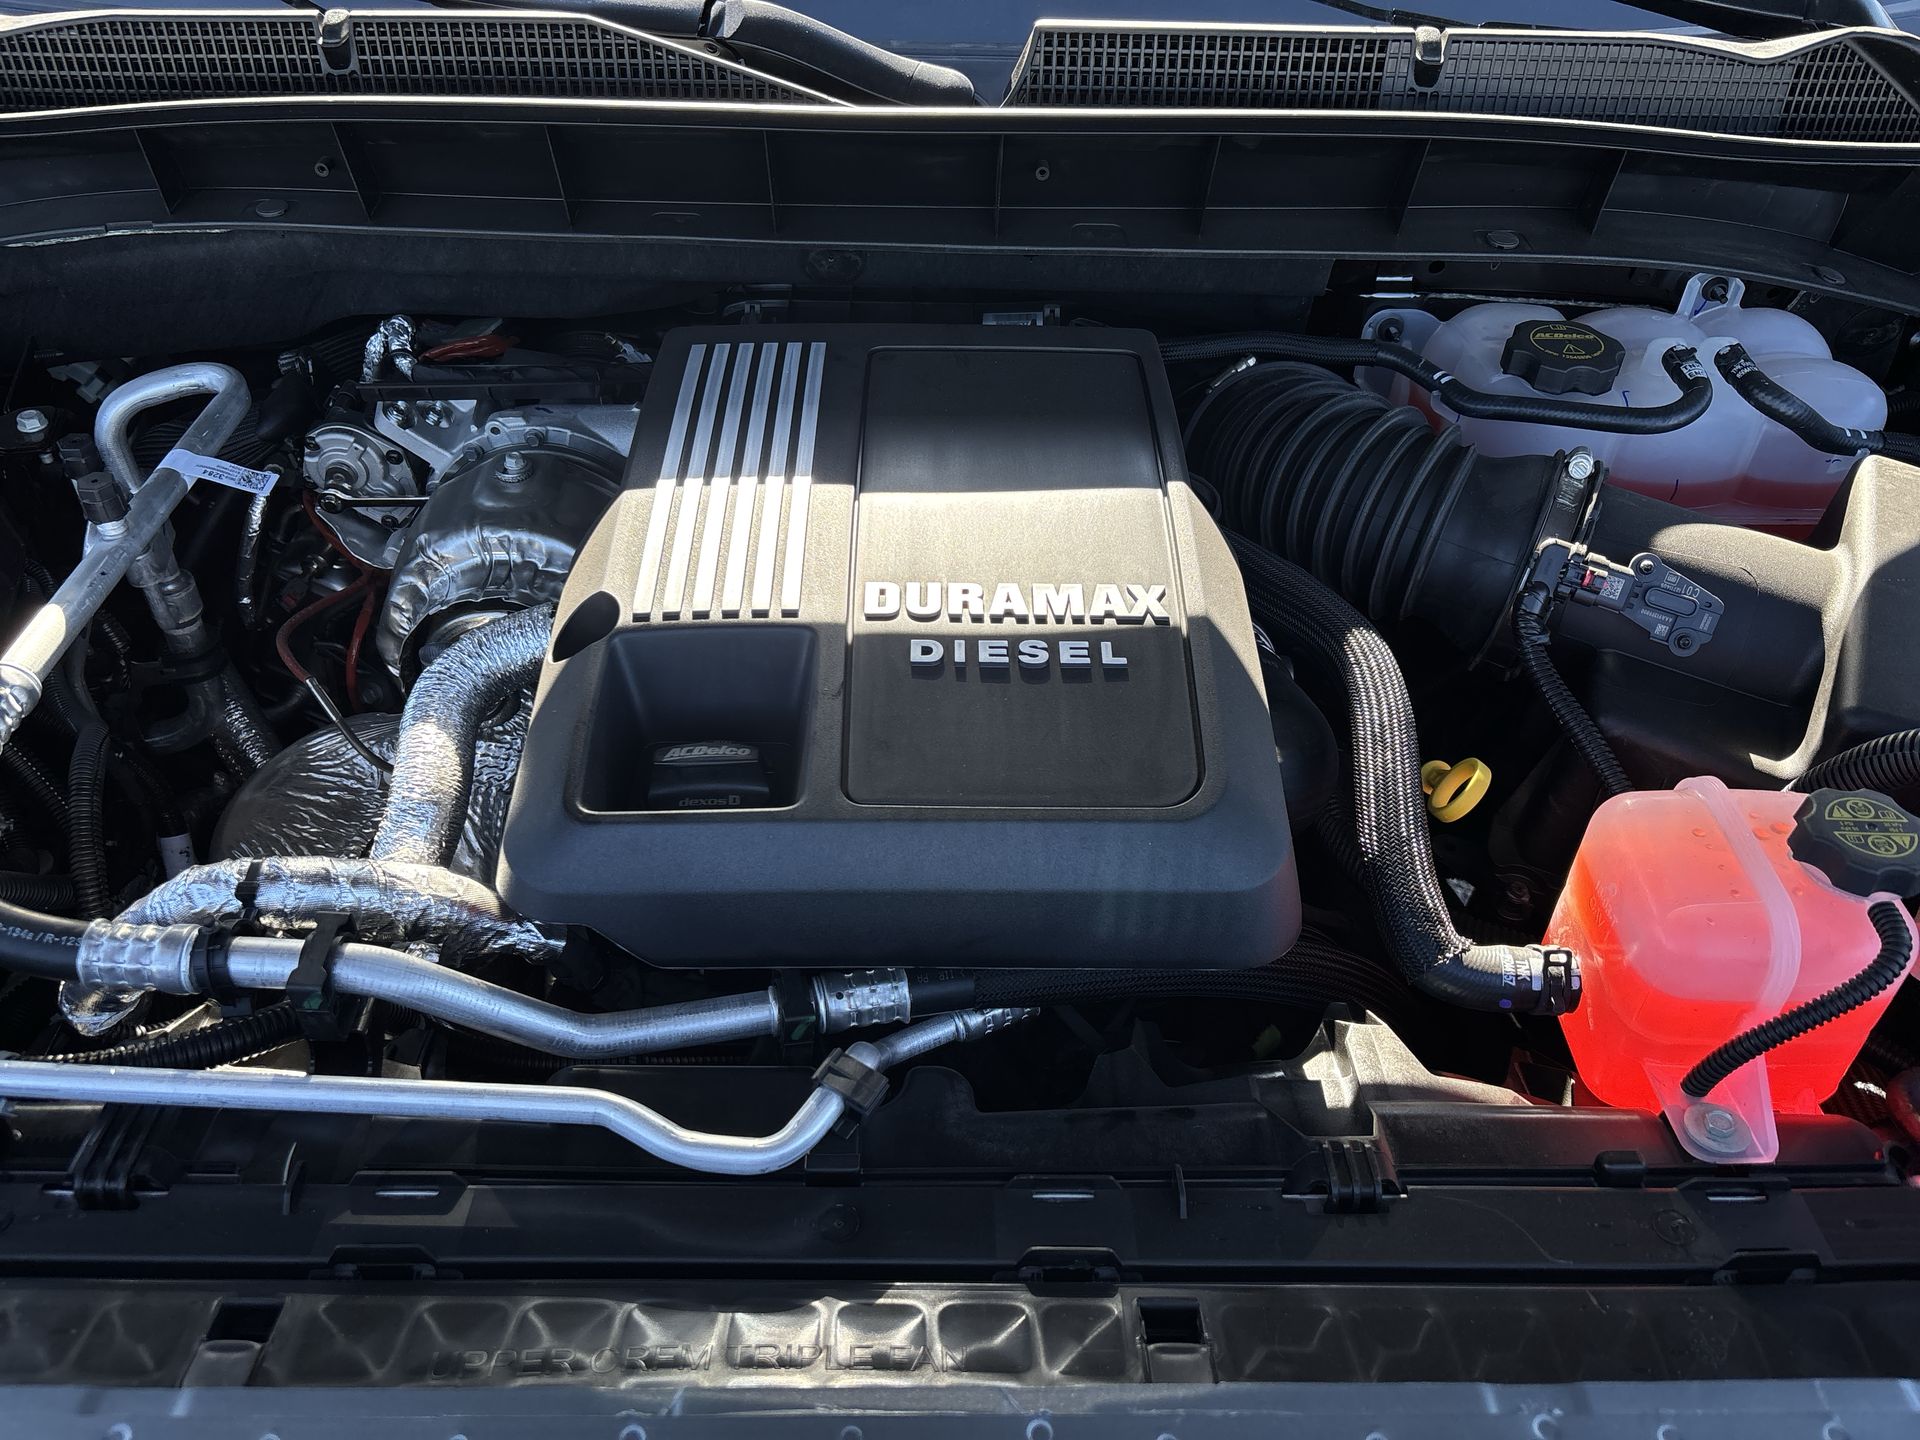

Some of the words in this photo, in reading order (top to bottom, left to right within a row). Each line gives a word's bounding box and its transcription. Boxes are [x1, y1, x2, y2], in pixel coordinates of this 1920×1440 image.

[202, 469, 225, 480] 3284
[863, 581, 1170, 625] DURAMAX
[909, 638, 1128, 667] DIESEL
[664, 744, 752, 760] ACDelco
[429, 1347, 576, 1380] UPPER
[731, 1342, 875, 1373] TRIPLE
[886, 1343, 970, 1374] FAN
